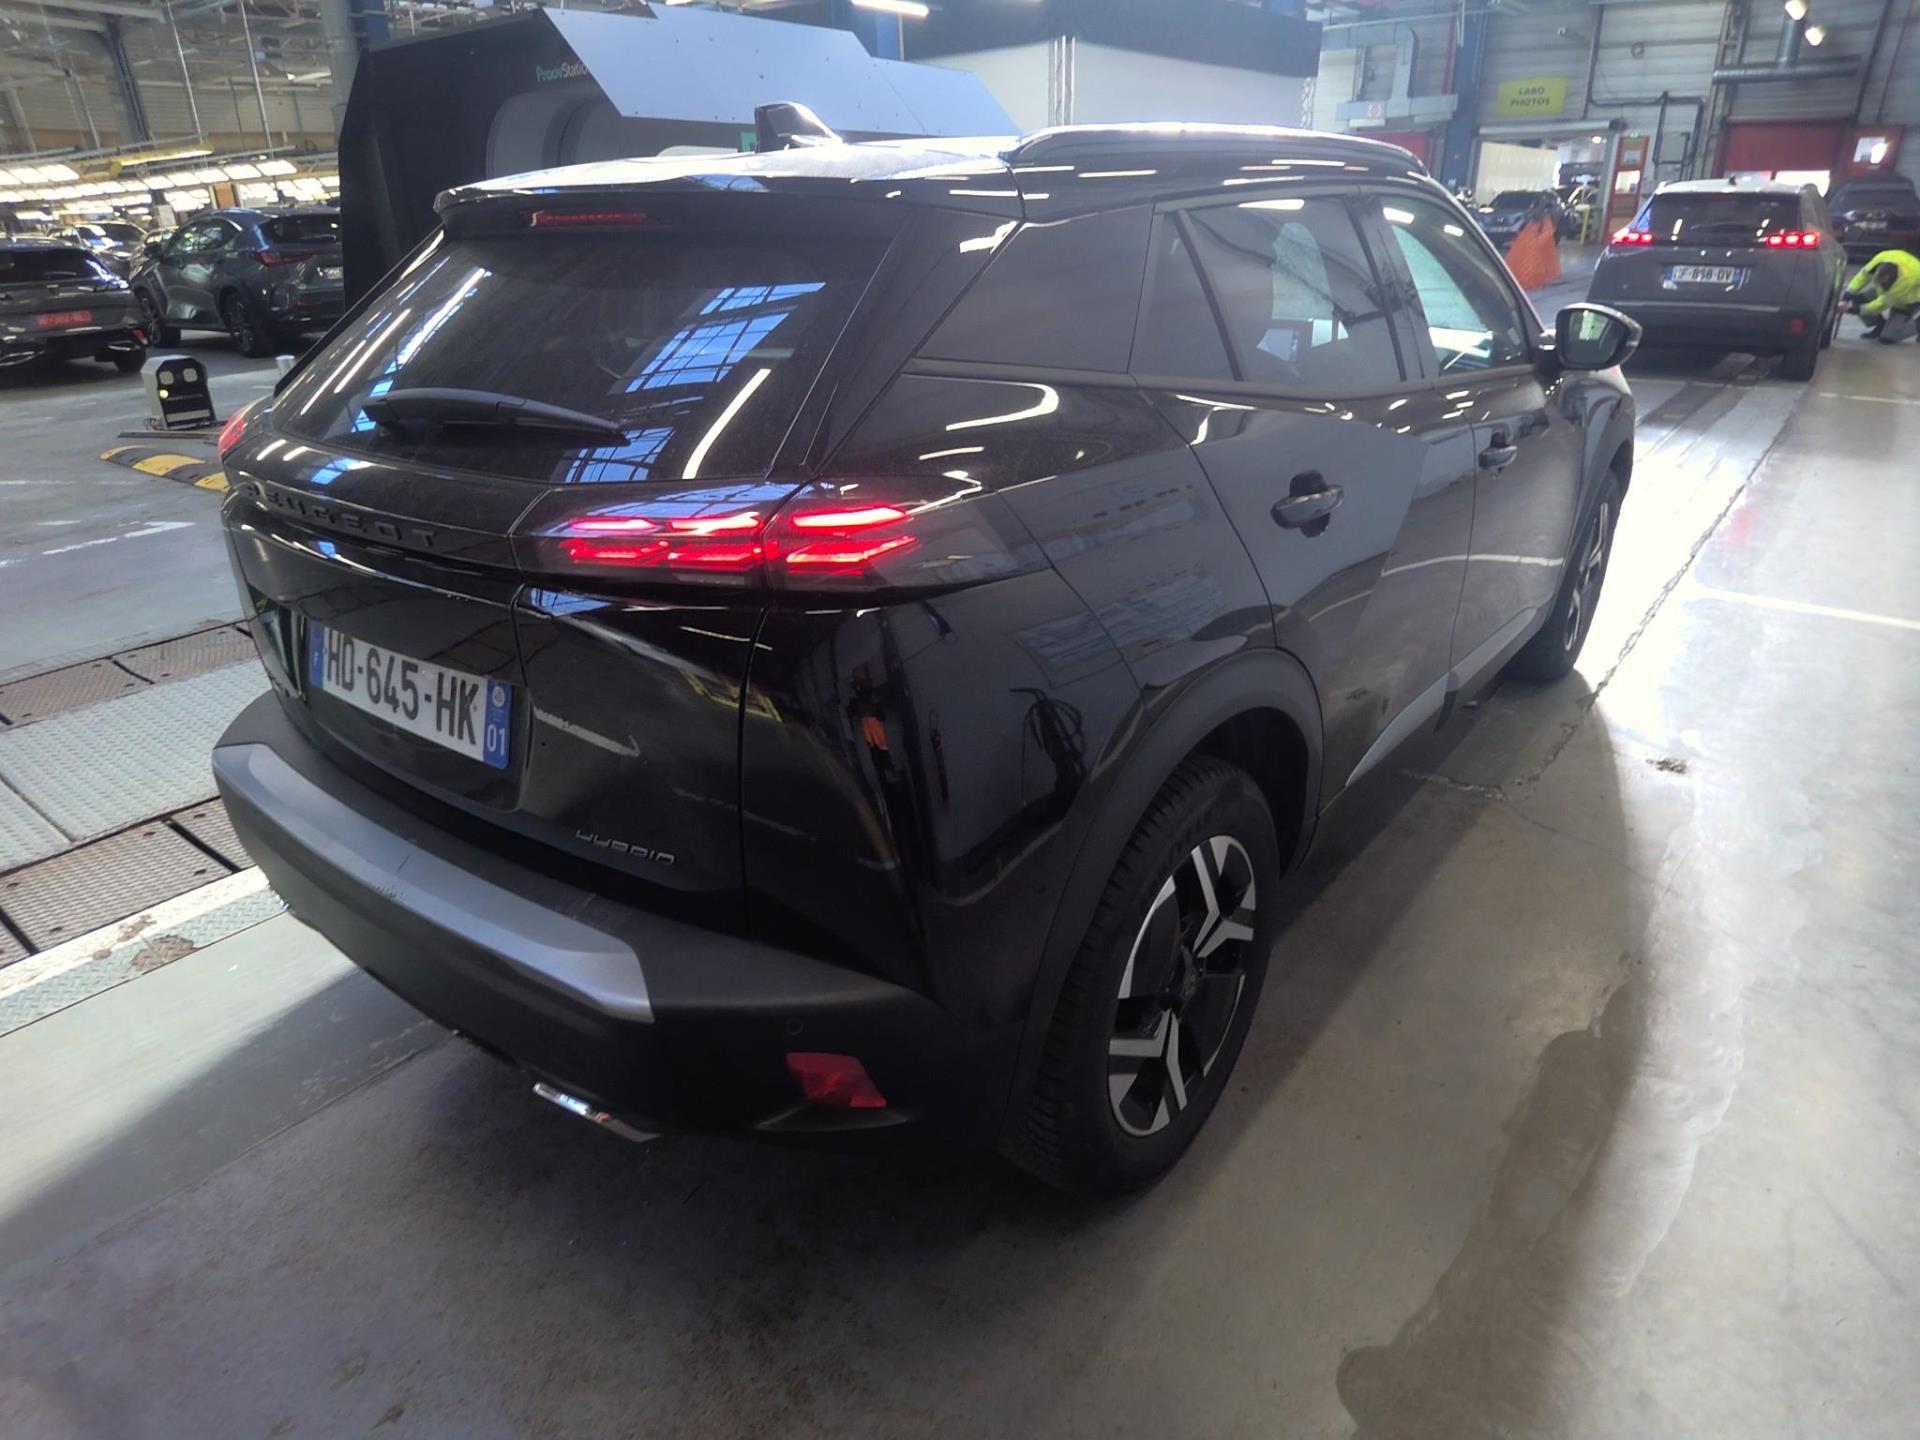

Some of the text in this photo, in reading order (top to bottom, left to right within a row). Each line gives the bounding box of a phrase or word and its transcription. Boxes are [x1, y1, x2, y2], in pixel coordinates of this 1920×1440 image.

[536, 61, 588, 83] ProovStatio
[327, 628, 480, 746] HD-645-HK
[487, 723, 506, 756] 01
